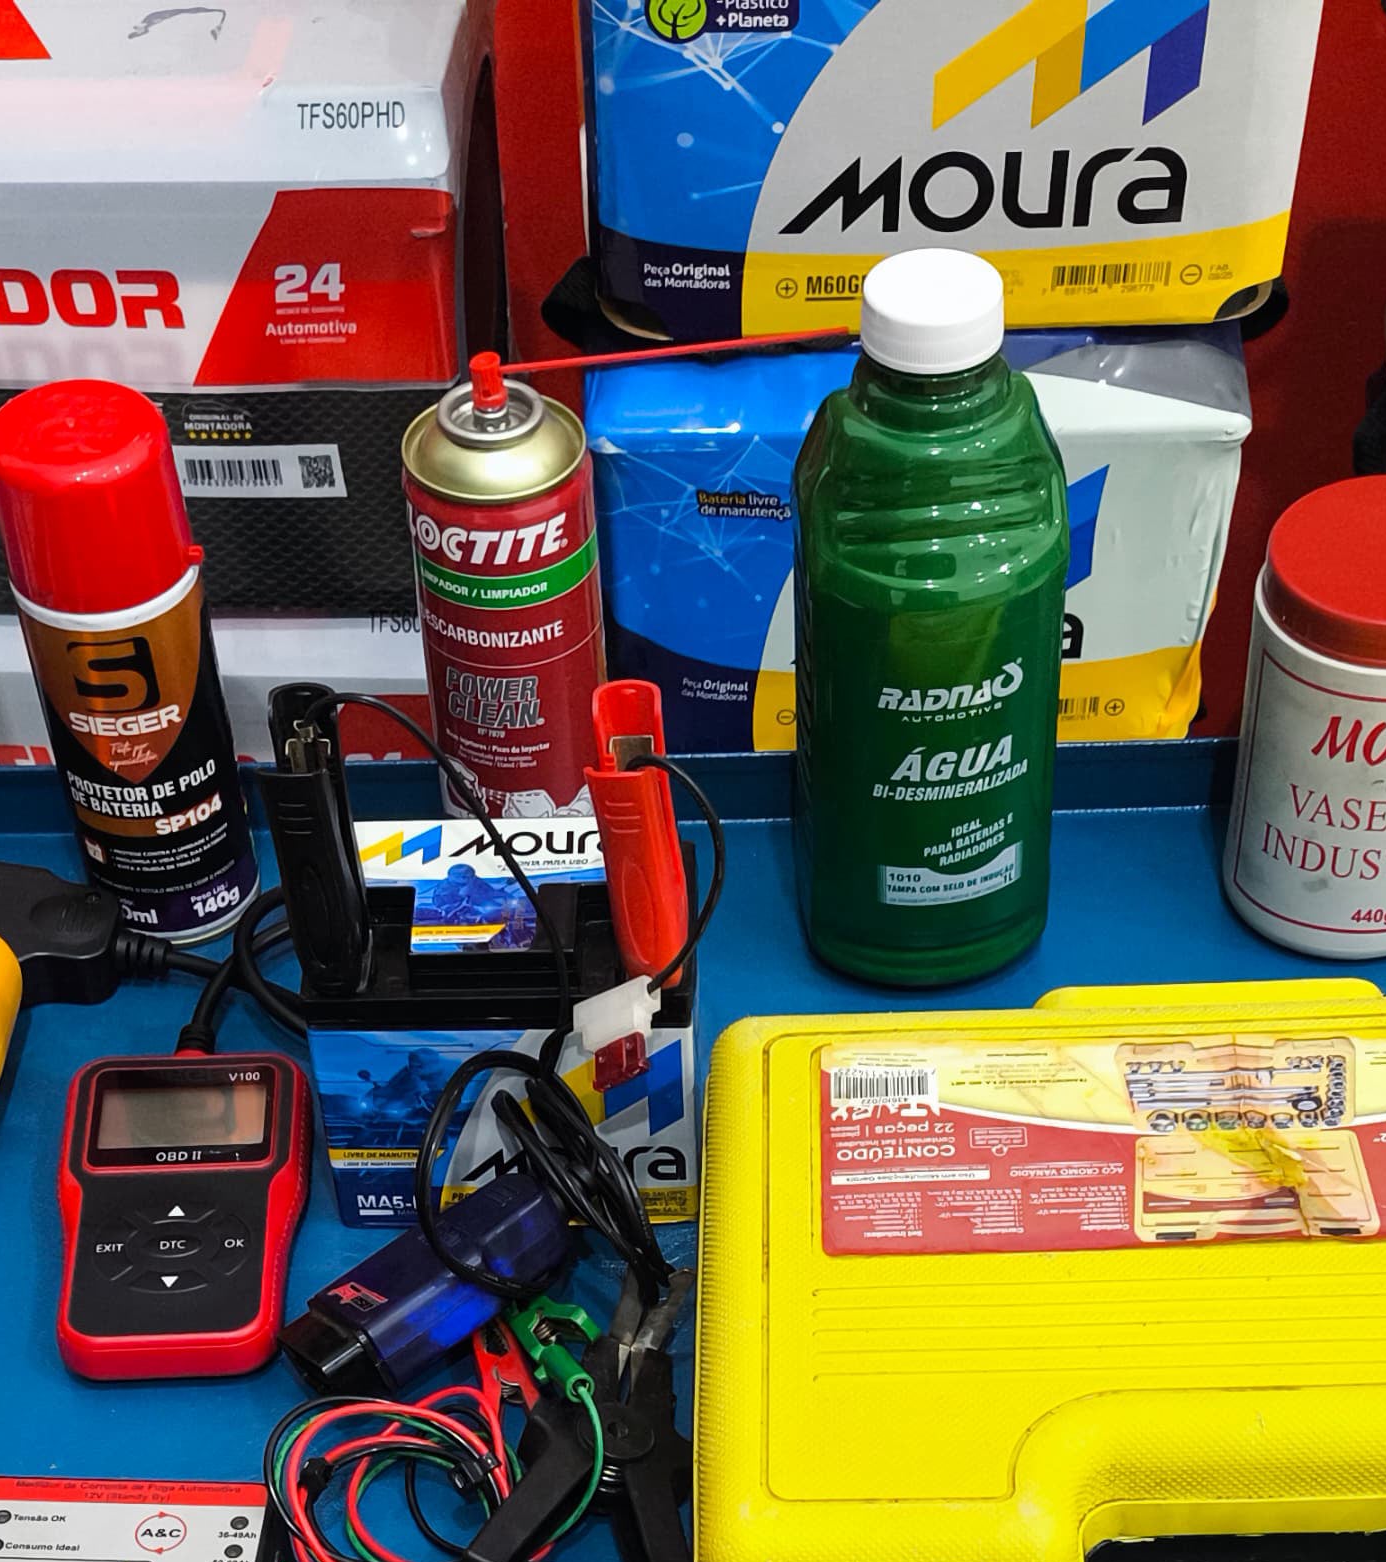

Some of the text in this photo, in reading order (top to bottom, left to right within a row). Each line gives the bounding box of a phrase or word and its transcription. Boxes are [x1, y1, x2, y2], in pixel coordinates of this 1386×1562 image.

[297, 101, 406, 131] TFS60PHD
[644, 263, 730, 279] Peça Original
[274, 262, 346, 304] 24
[644, 278, 730, 289] das Montadoras
[806, 275, 865, 294] M60G
[265, 319, 358, 337] Automotiva
[184, 422, 253, 431] MONTADORA
[699, 492, 778, 506] Bateria livre
[700, 506, 792, 520] de manutençã
[480, 582, 548, 600] LIMPIADOR
[446, 666, 539, 701] POWER
[703, 679, 749, 694] Original
[448, 692, 541, 729] CLEAN
[901, 702, 1003, 723] AUTOMOTIVE
[68, 704, 182, 737] SIEGER
[890, 734, 1013, 782] ÁGUA
[66, 759, 216, 803] PROTETOR DE POLO
[872, 759, 1028, 801] BI-DESMINERALIZADA
[92, 795, 163, 818] BATERIA
[154, 794, 222, 835] SP104
[951, 817, 982, 838] IDEAL
[924, 818, 1005, 857] PARA BATERIAS
[939, 832, 1005, 867] RADIADORES
[889, 873, 921, 882] 1010
[887, 881, 964, 894] TAMPA COM SELO
[193, 886, 241, 918] 140g
[229, 1071, 261, 1082] V100
[874, 1121, 954, 1134] 22 peças
[156, 1150, 202, 1162] OBD II
[836, 1145, 956, 1163] CONTEÚDO
[95, 1243, 124, 1254] EXIT
[159, 1239, 187, 1250] DTC
[224, 1238, 245, 1249] OK
[14, 1513, 66, 1523] Tensão OK
[141, 1527, 182, 1539] A&C
[5, 1541, 80, 1551] Consumo Ideal
